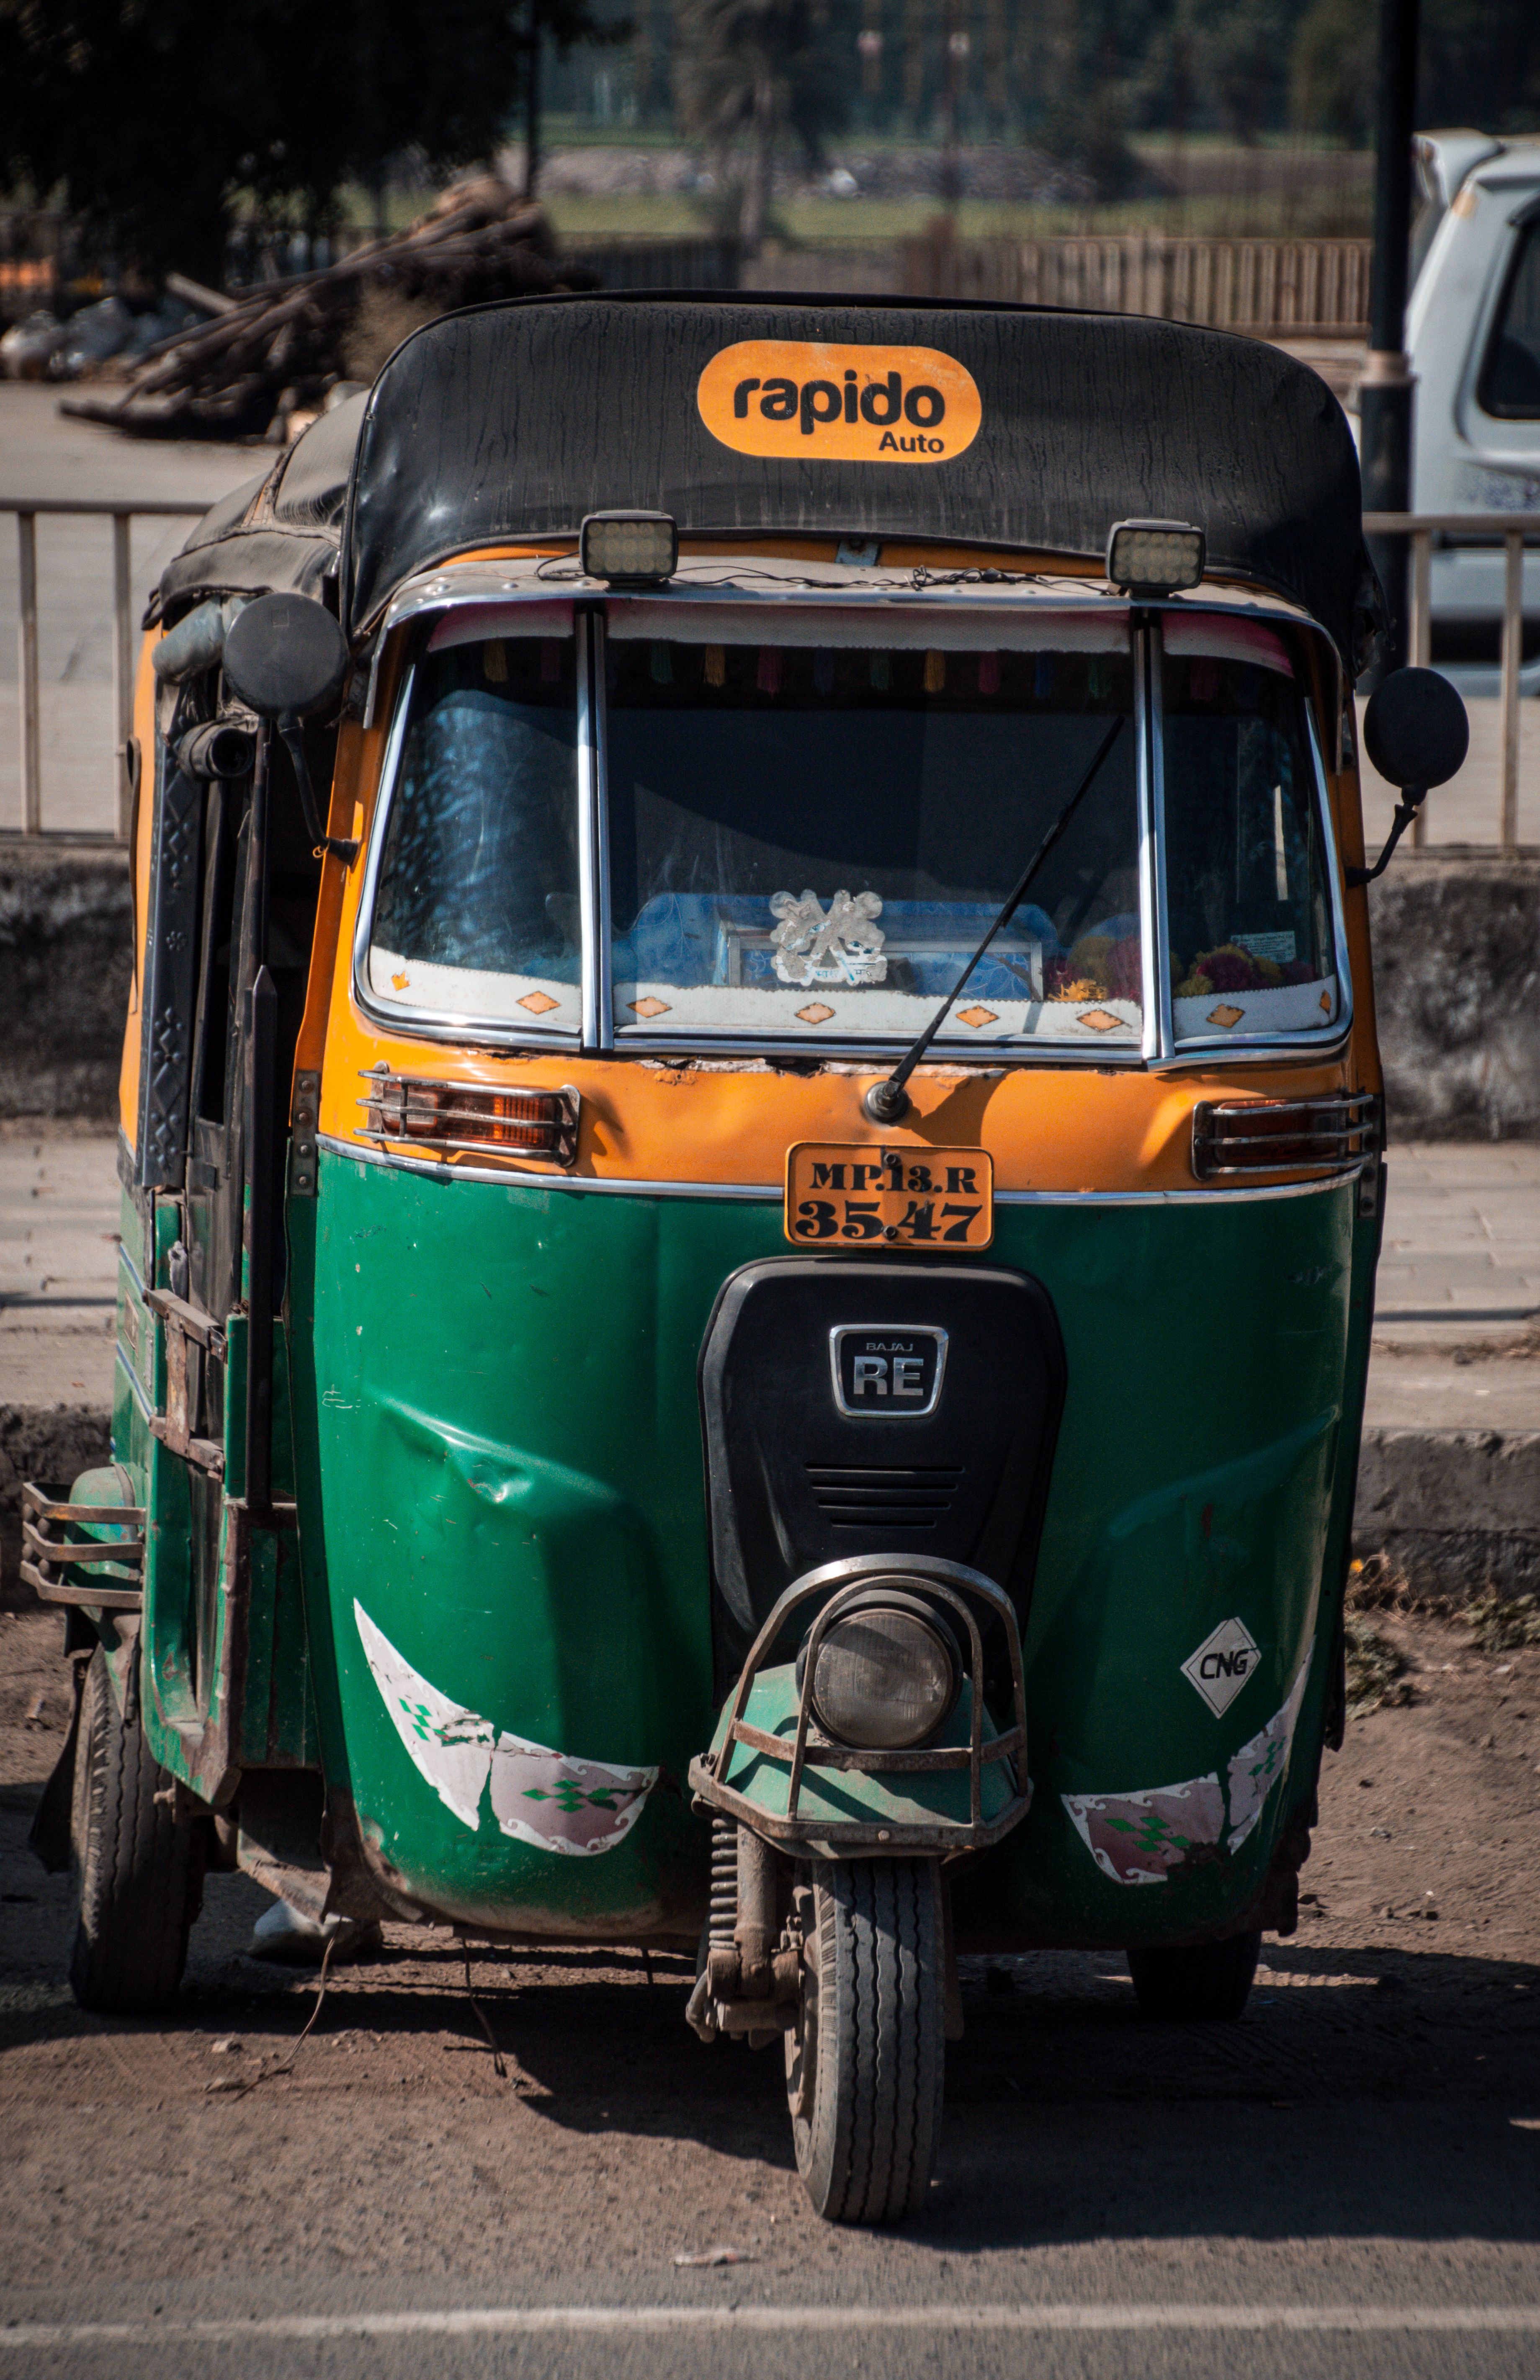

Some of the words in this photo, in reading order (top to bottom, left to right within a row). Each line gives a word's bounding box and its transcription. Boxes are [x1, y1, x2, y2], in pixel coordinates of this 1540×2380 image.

[734, 369, 945, 435] rapido
[879, 431, 944, 454] Auto
[866, 1342, 914, 1351] BAJAJ
[853, 1356, 924, 1396] RE
[1200, 1649, 1249, 1680] CNG
